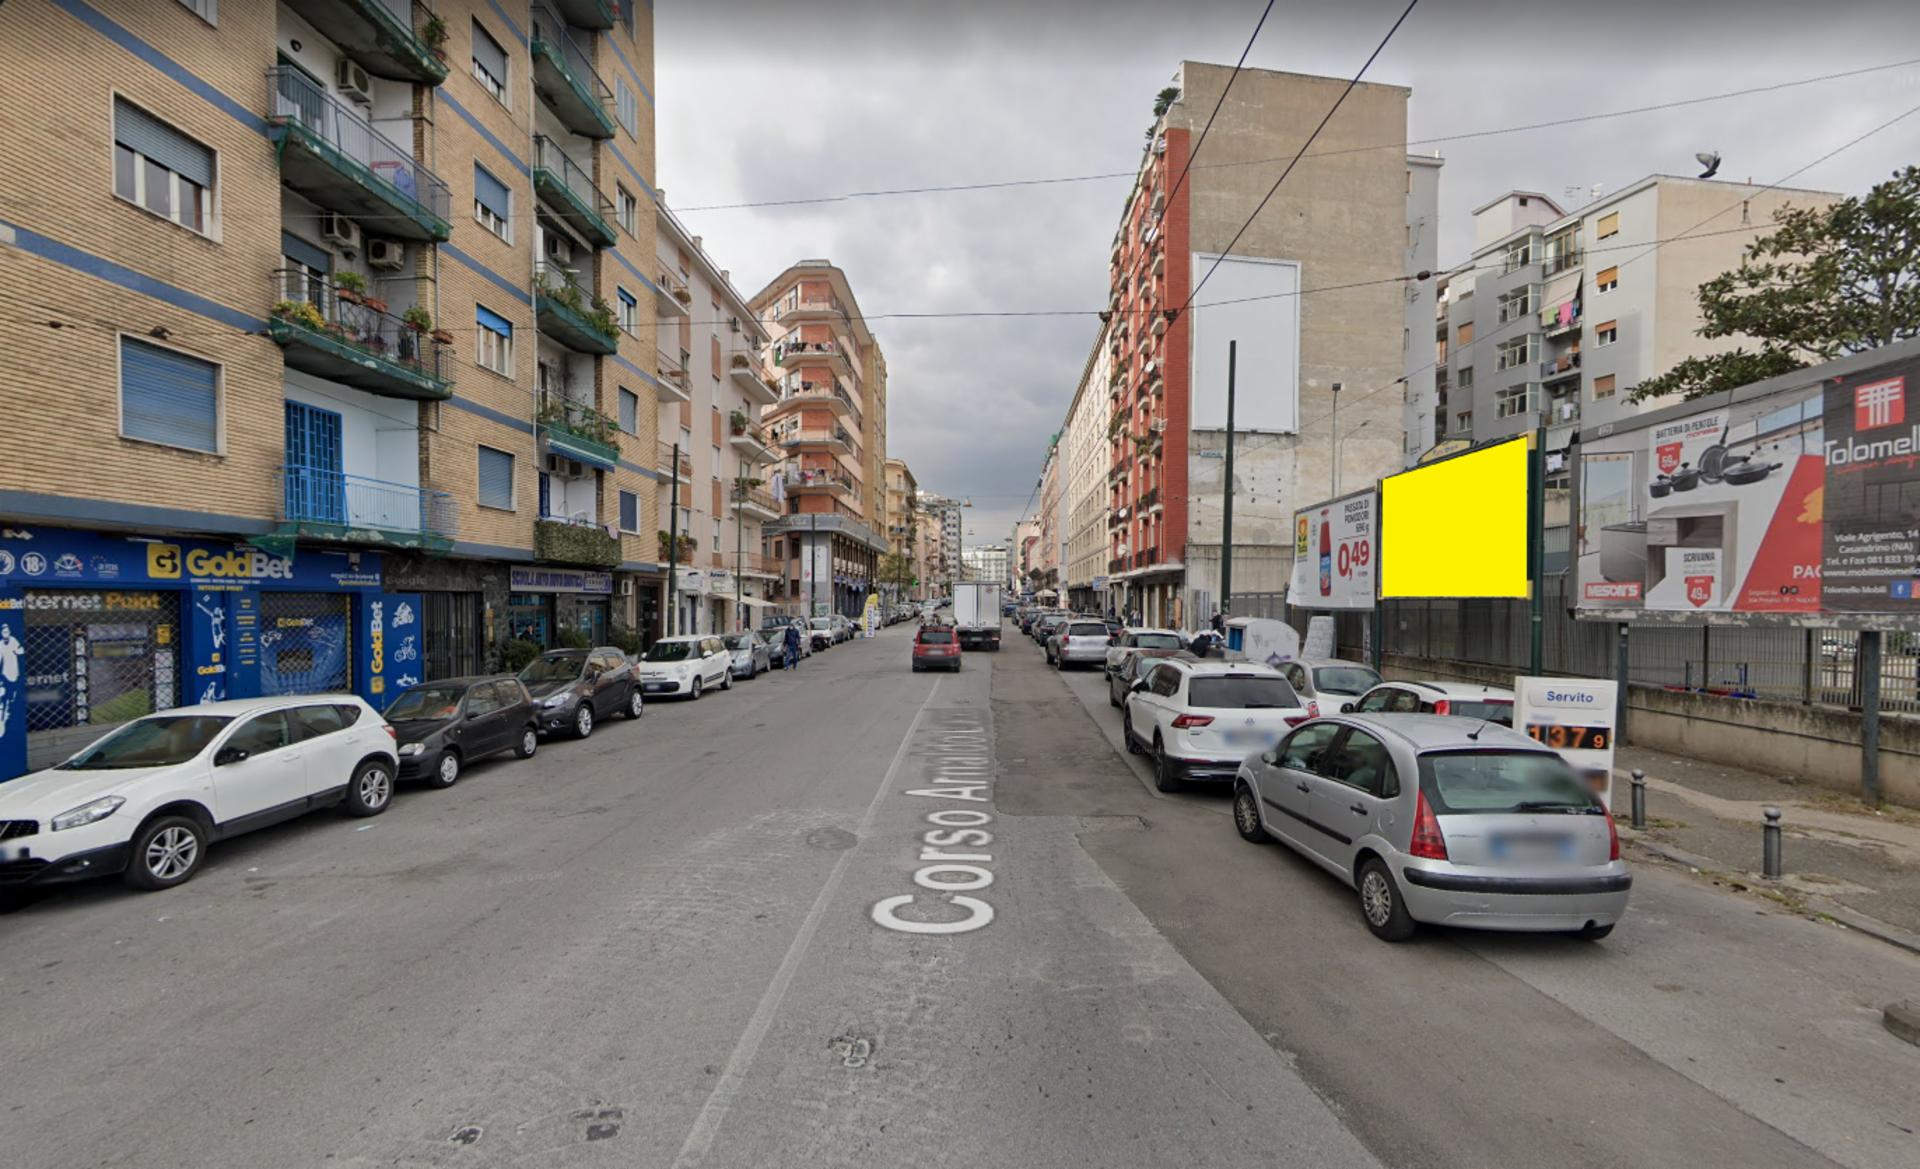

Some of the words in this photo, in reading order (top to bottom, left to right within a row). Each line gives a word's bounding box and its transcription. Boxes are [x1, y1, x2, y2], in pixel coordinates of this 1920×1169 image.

[1834, 534, 1856, 542] Viale
[1908, 529, 1919, 538] 14
[186, 549, 293, 579] GoldBet
[1338, 540, 1370, 580] 0,49
[106, 593, 160, 611] Point
[370, 601, 384, 673] GoldBet
[1547, 691, 1593, 703] Servito
